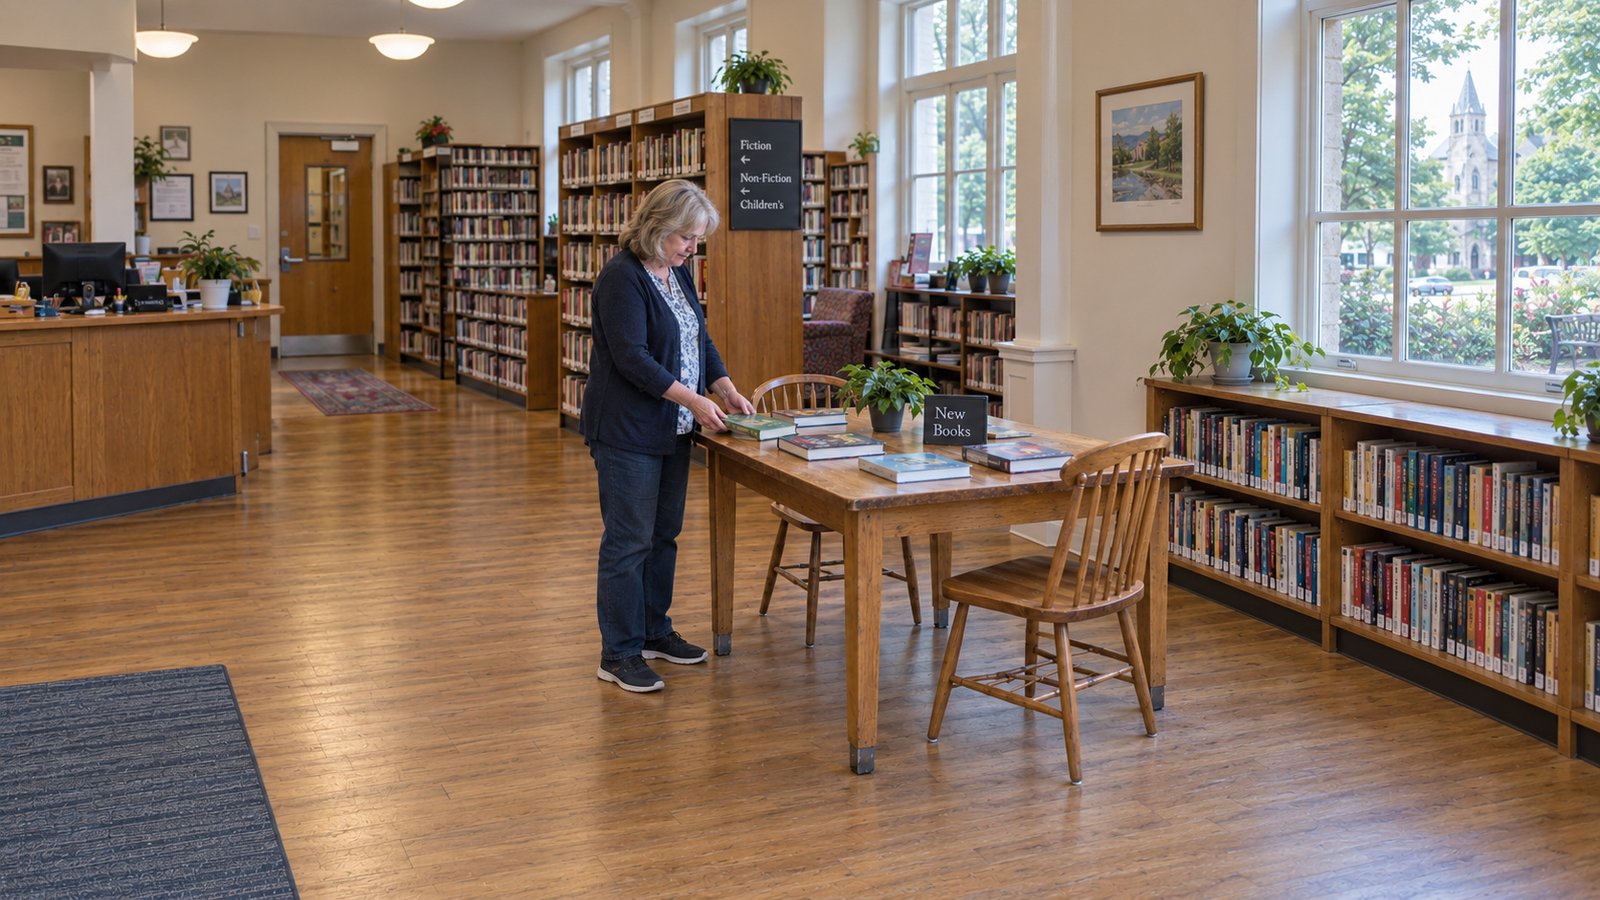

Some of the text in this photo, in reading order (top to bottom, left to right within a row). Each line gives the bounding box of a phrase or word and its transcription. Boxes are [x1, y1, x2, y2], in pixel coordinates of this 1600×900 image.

[740, 139, 772, 150] Fiction
[740, 173, 792, 183] Non-Fiction
[740, 199, 784, 210] Children's
[934, 406, 966, 420] New
[933, 423, 971, 437] Books
